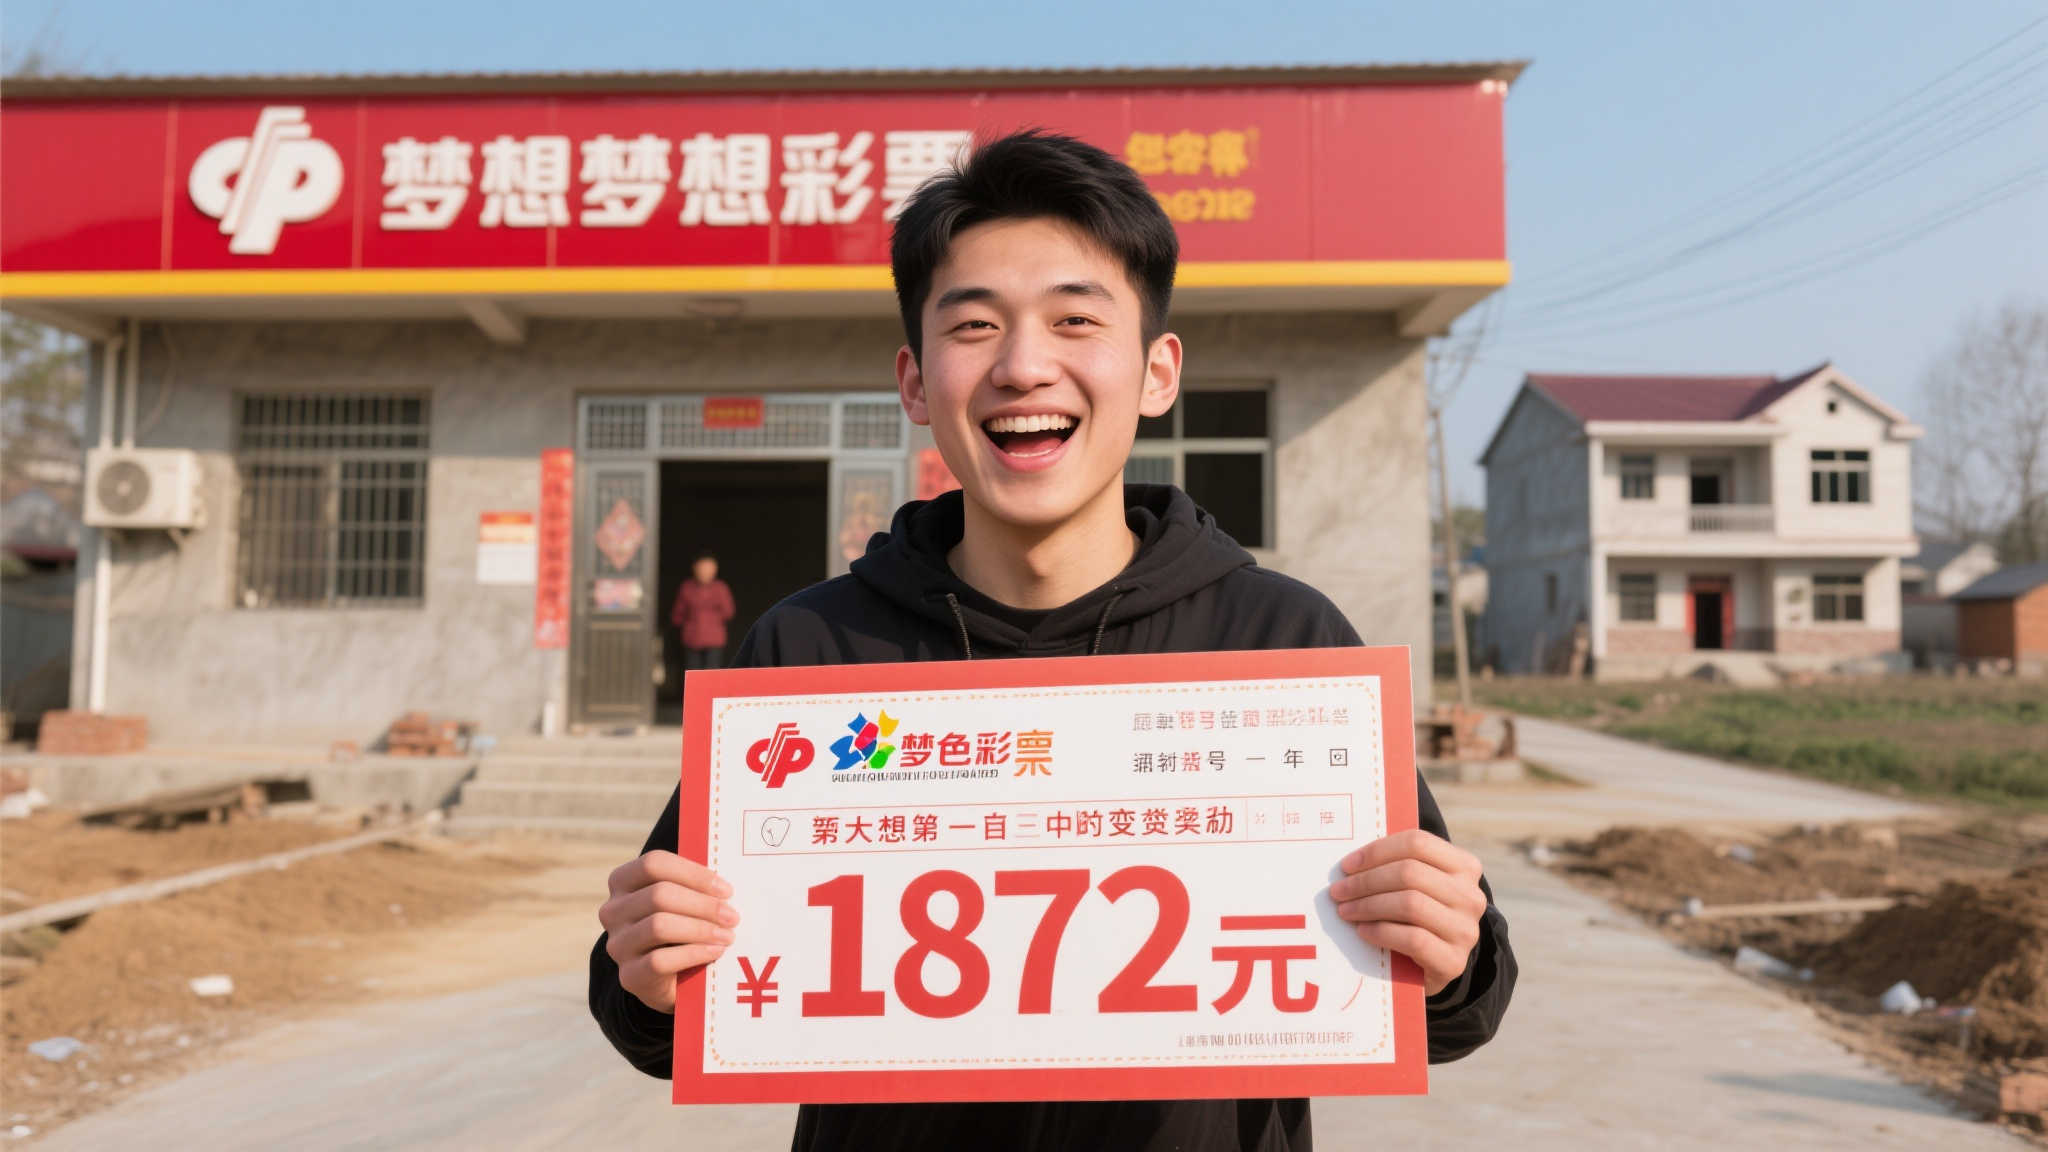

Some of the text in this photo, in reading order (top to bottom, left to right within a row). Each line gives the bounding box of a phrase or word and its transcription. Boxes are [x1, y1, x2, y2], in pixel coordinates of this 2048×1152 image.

[381, 131, 974, 230] 梦想梦想彩票
